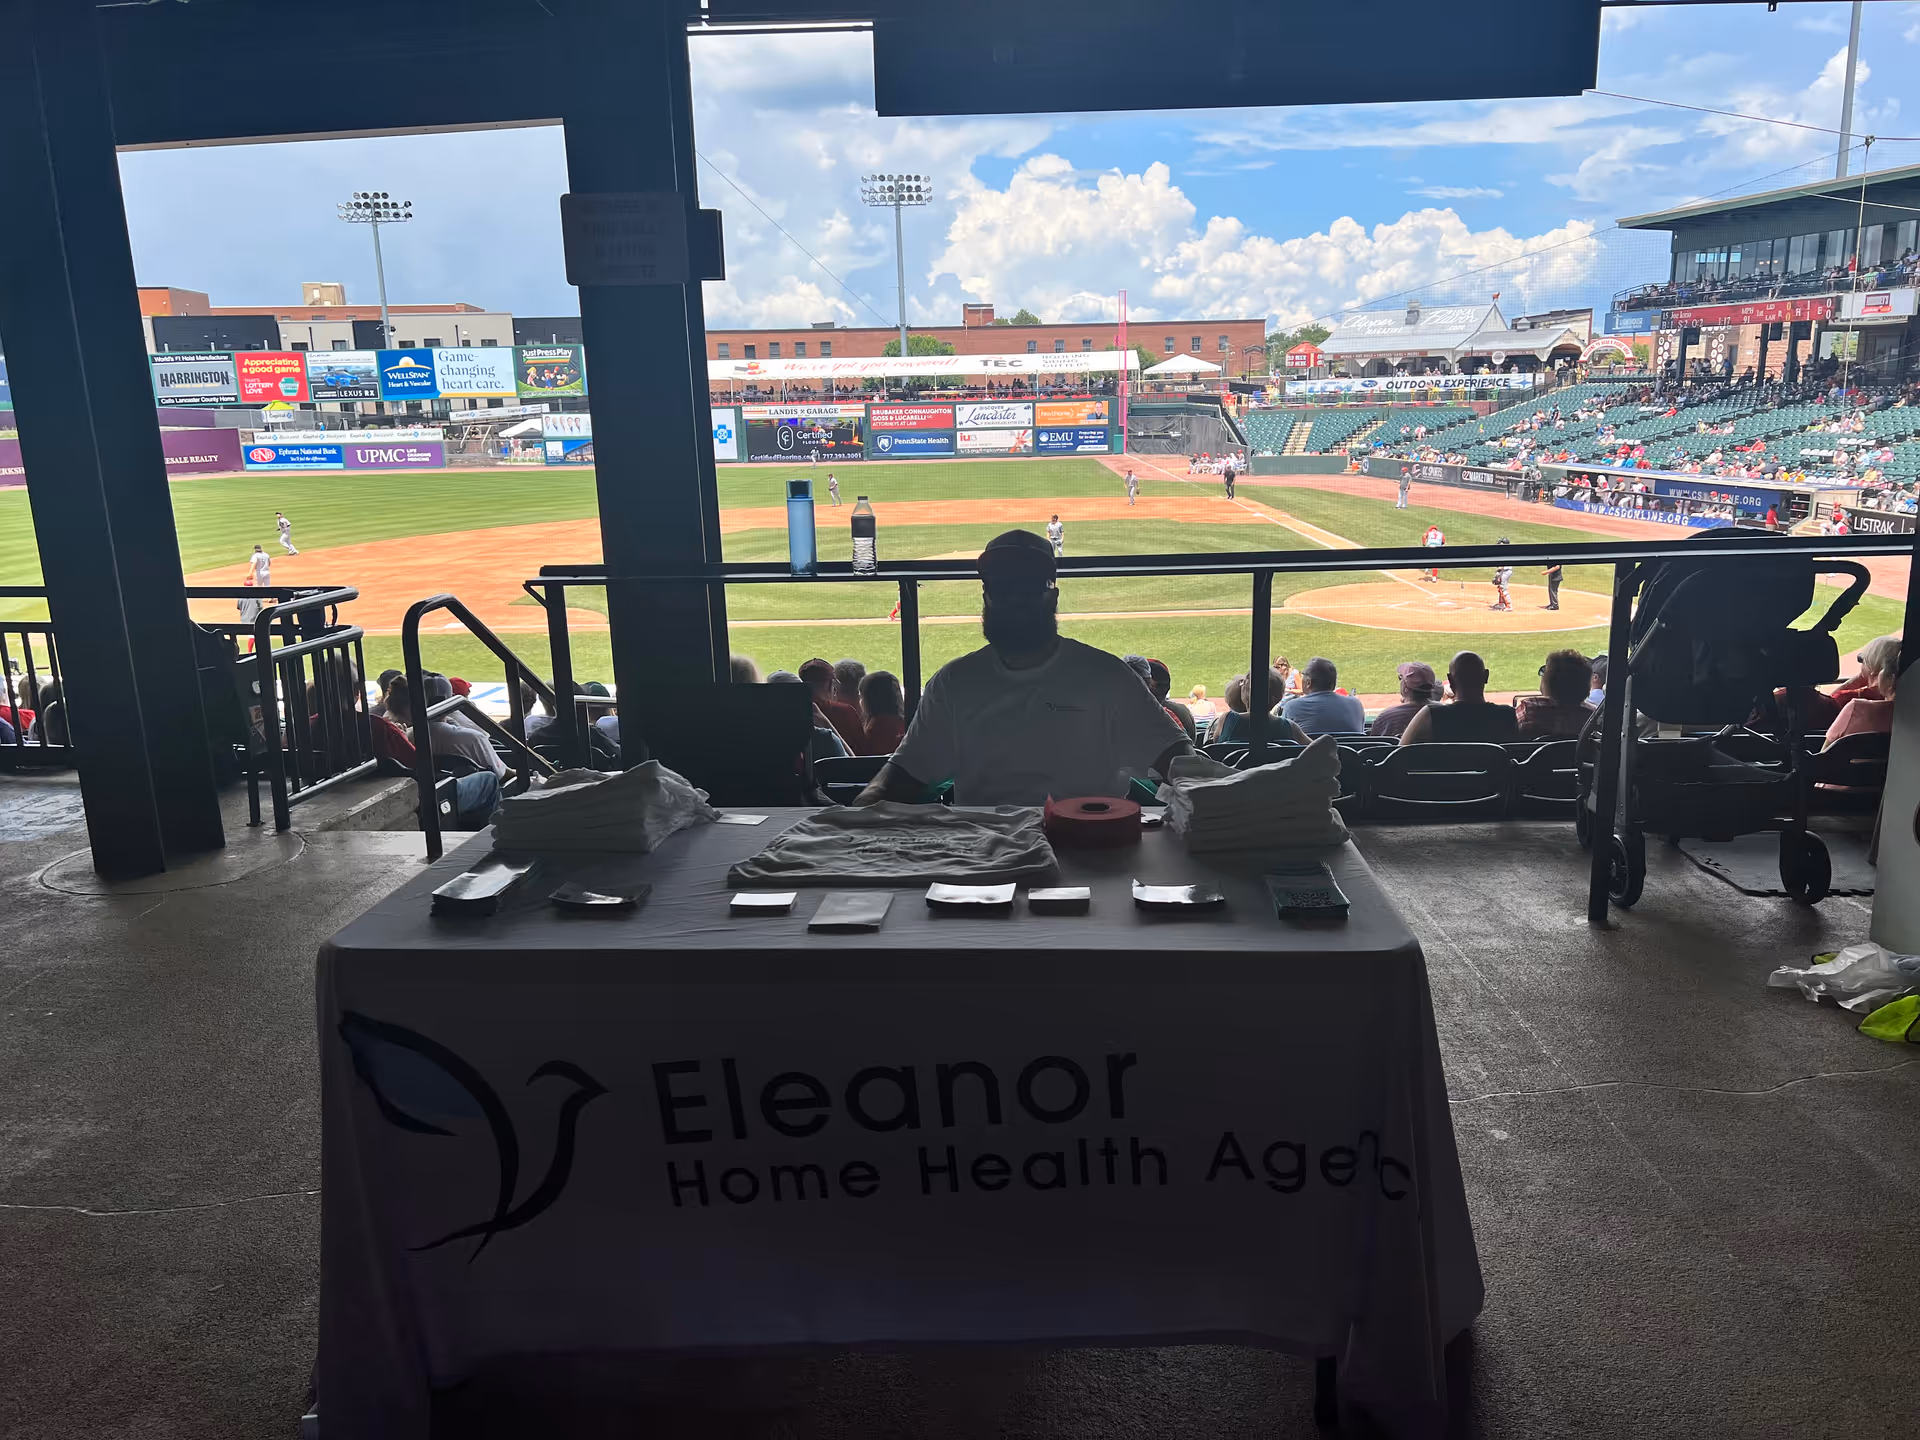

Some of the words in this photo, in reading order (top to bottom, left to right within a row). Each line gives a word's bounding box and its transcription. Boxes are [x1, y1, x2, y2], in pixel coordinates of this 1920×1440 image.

[1786, 302, 1792, 310] 0
[1826, 298, 1832, 308] 0
[1786, 312, 1790, 321] 0
[1826, 310, 1832, 319] 0
[1796, 308, 1802, 316] H
[1744, 316, 1750, 324] 91
[438, 350, 479, 362] Game-
[536, 348, 556, 356] Press
[556, 348, 573, 357] Play
[244, 358, 300, 366] Appreciating
[979, 359, 1023, 368] TEC
[248, 366, 272, 374] good
[274, 366, 300, 374] game
[440, 364, 496, 378] changing
[160, 371, 230, 388] HARRINGTON
[442, 378, 473, 390] heart
[475, 379, 505, 389] care.
[340, 390, 362, 398] LEXUS
[768, 408, 798, 416] LANDIS
[965, 407, 1017, 426] Lancaster
[796, 430, 833, 439] Certified
[1049, 432, 1074, 442] EMU
[190, 454, 218, 463] REALTY
[253, 450, 274, 462] ENB
[356, 448, 406, 464] UPMC
[1854, 516, 1894, 534] LISTRAK
[651, 1051, 1138, 1146] Eleanor
[665, 1159, 882, 1209] Home
[918, 1137, 1169, 1196] Health
